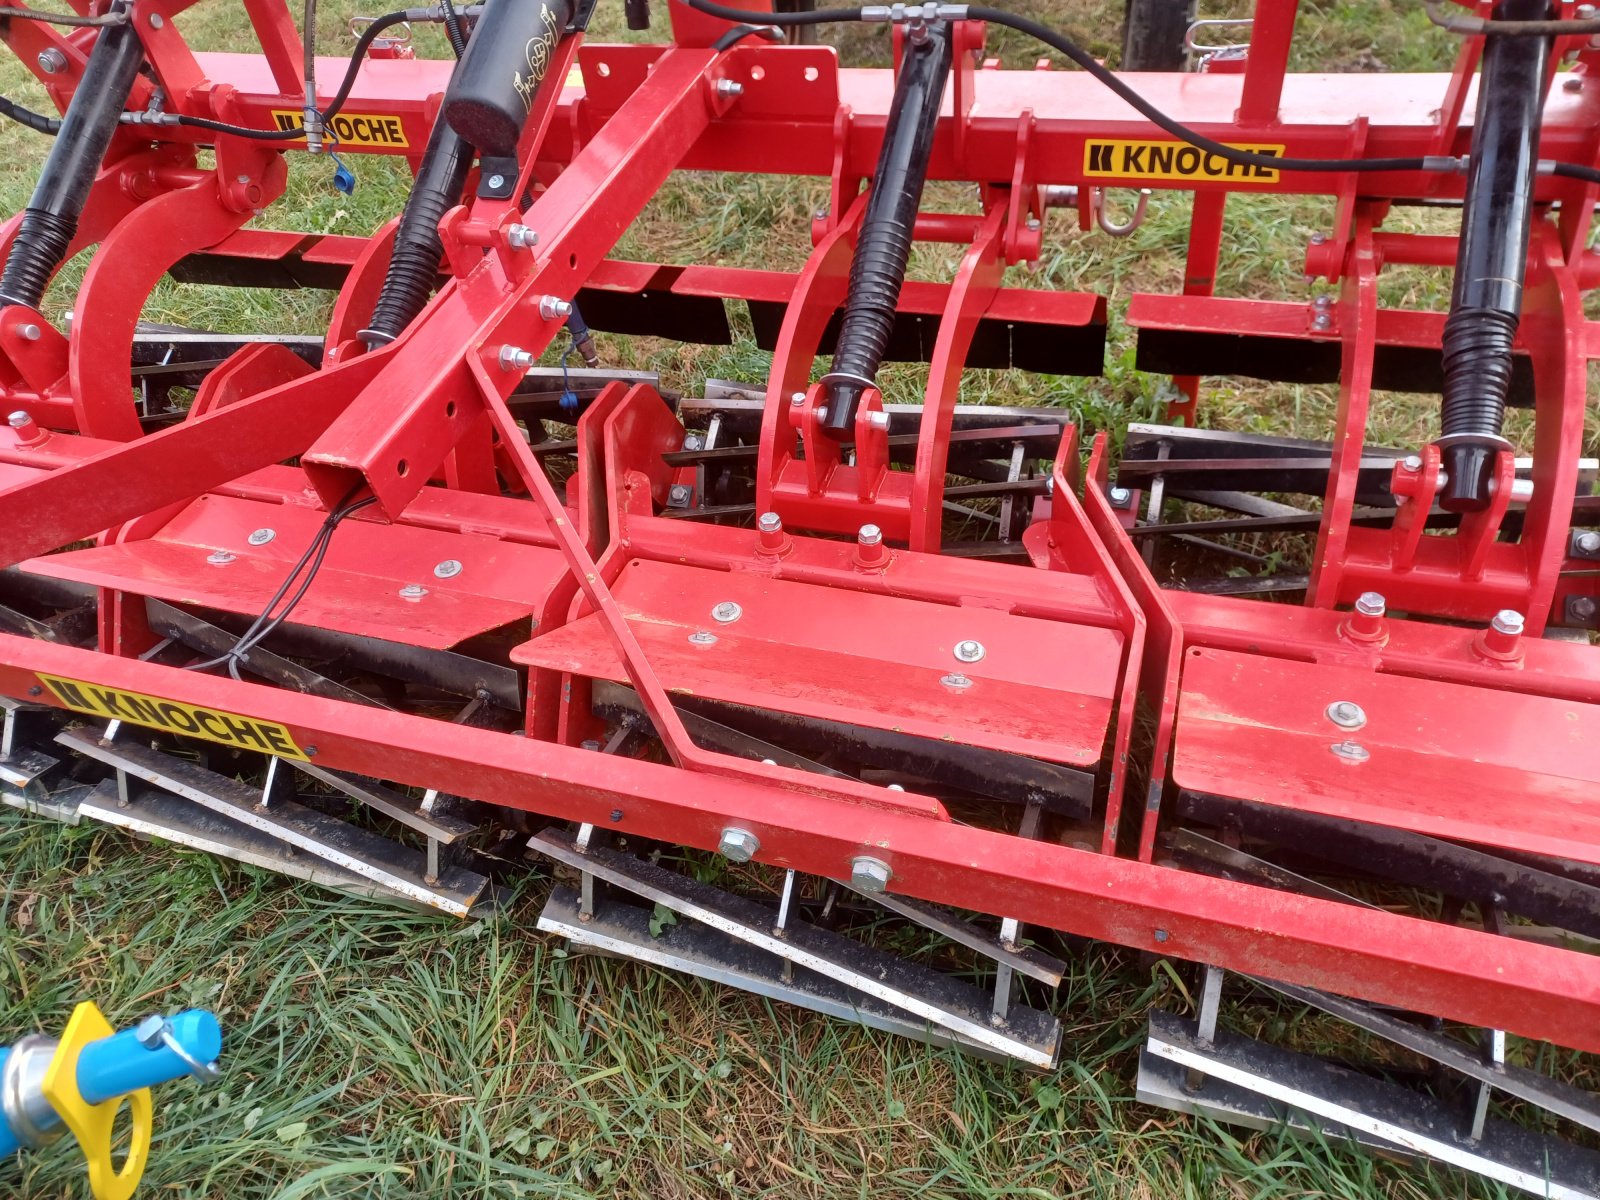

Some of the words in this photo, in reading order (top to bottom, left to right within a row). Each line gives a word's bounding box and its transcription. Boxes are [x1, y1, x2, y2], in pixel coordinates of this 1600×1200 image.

[298, 115, 403, 144] OCHE
[1123, 145, 1277, 177] KNOCHE
[88, 687, 300, 755] KNOCHE
